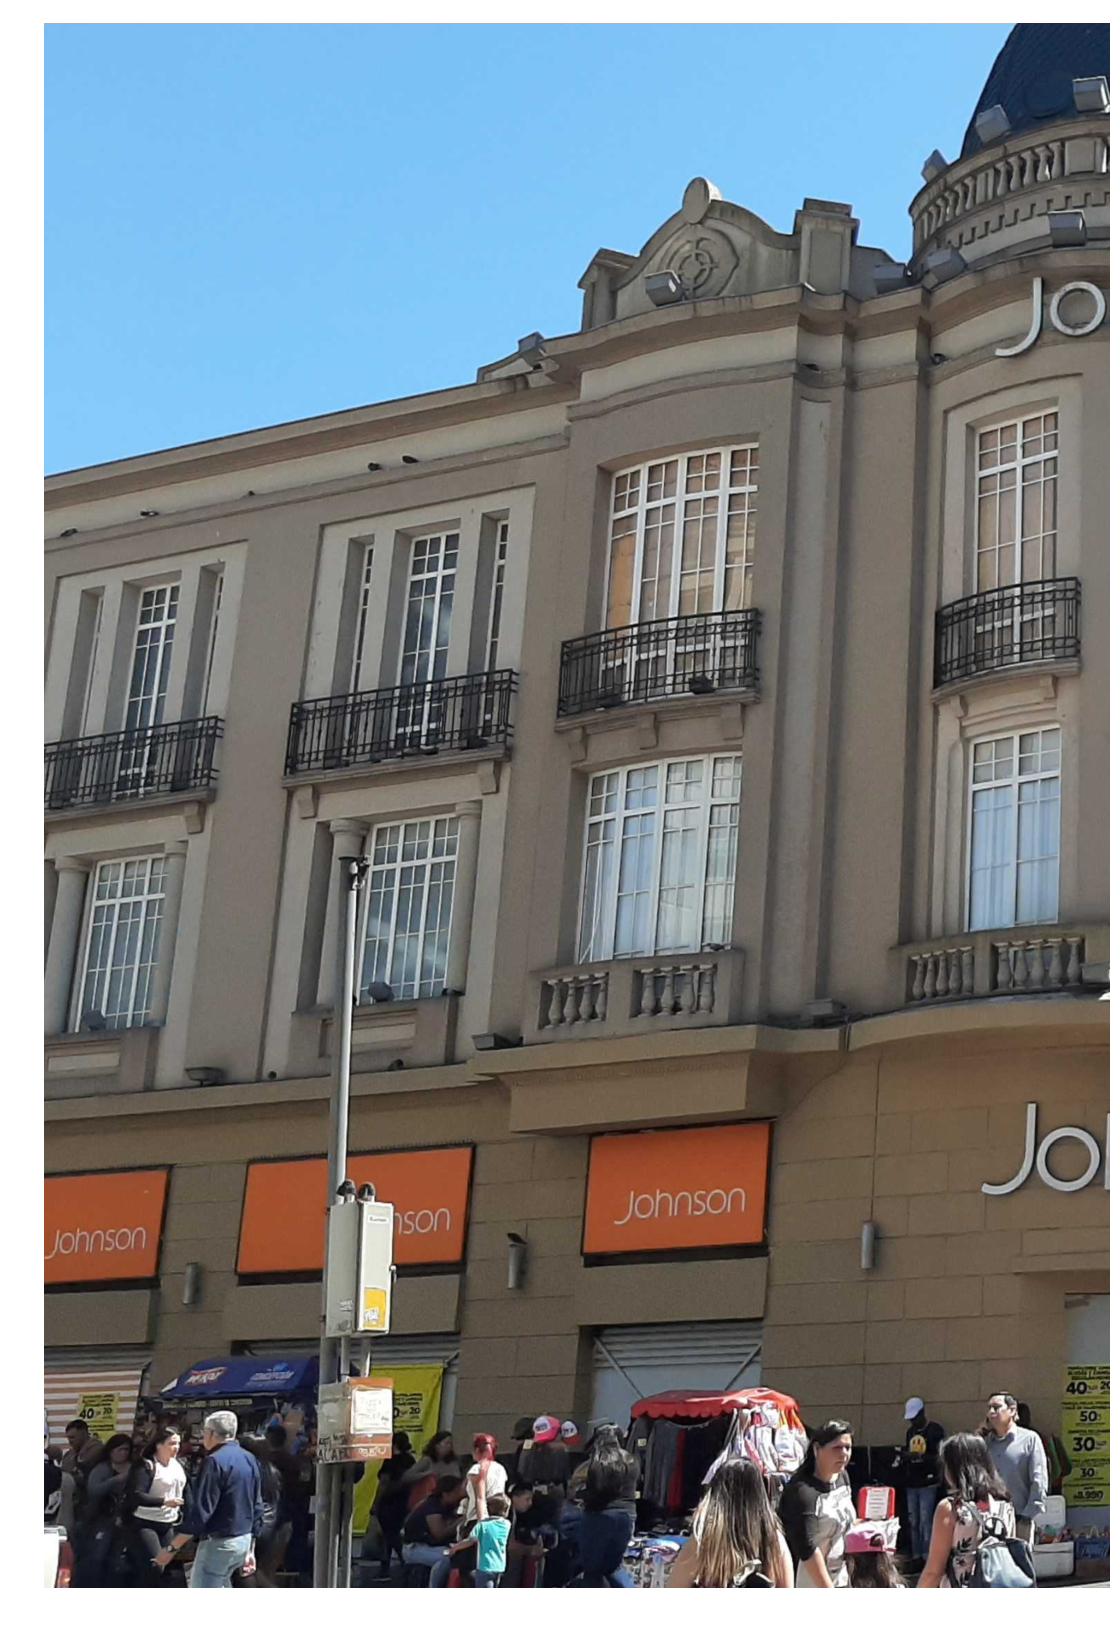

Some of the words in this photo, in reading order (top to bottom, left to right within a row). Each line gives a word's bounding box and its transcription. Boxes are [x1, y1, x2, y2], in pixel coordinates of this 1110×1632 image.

[614, 1187, 747, 1225] Johnson
[44, 1227, 147, 1260] Johnson
[1066, 1381, 1088, 1395] 40
[78, 1407, 95, 1419] 40
[1079, 1410, 1098, 1422] 50
[1072, 1436, 1096, 1452] 30
[1080, 1467, 1095, 1478] 30
